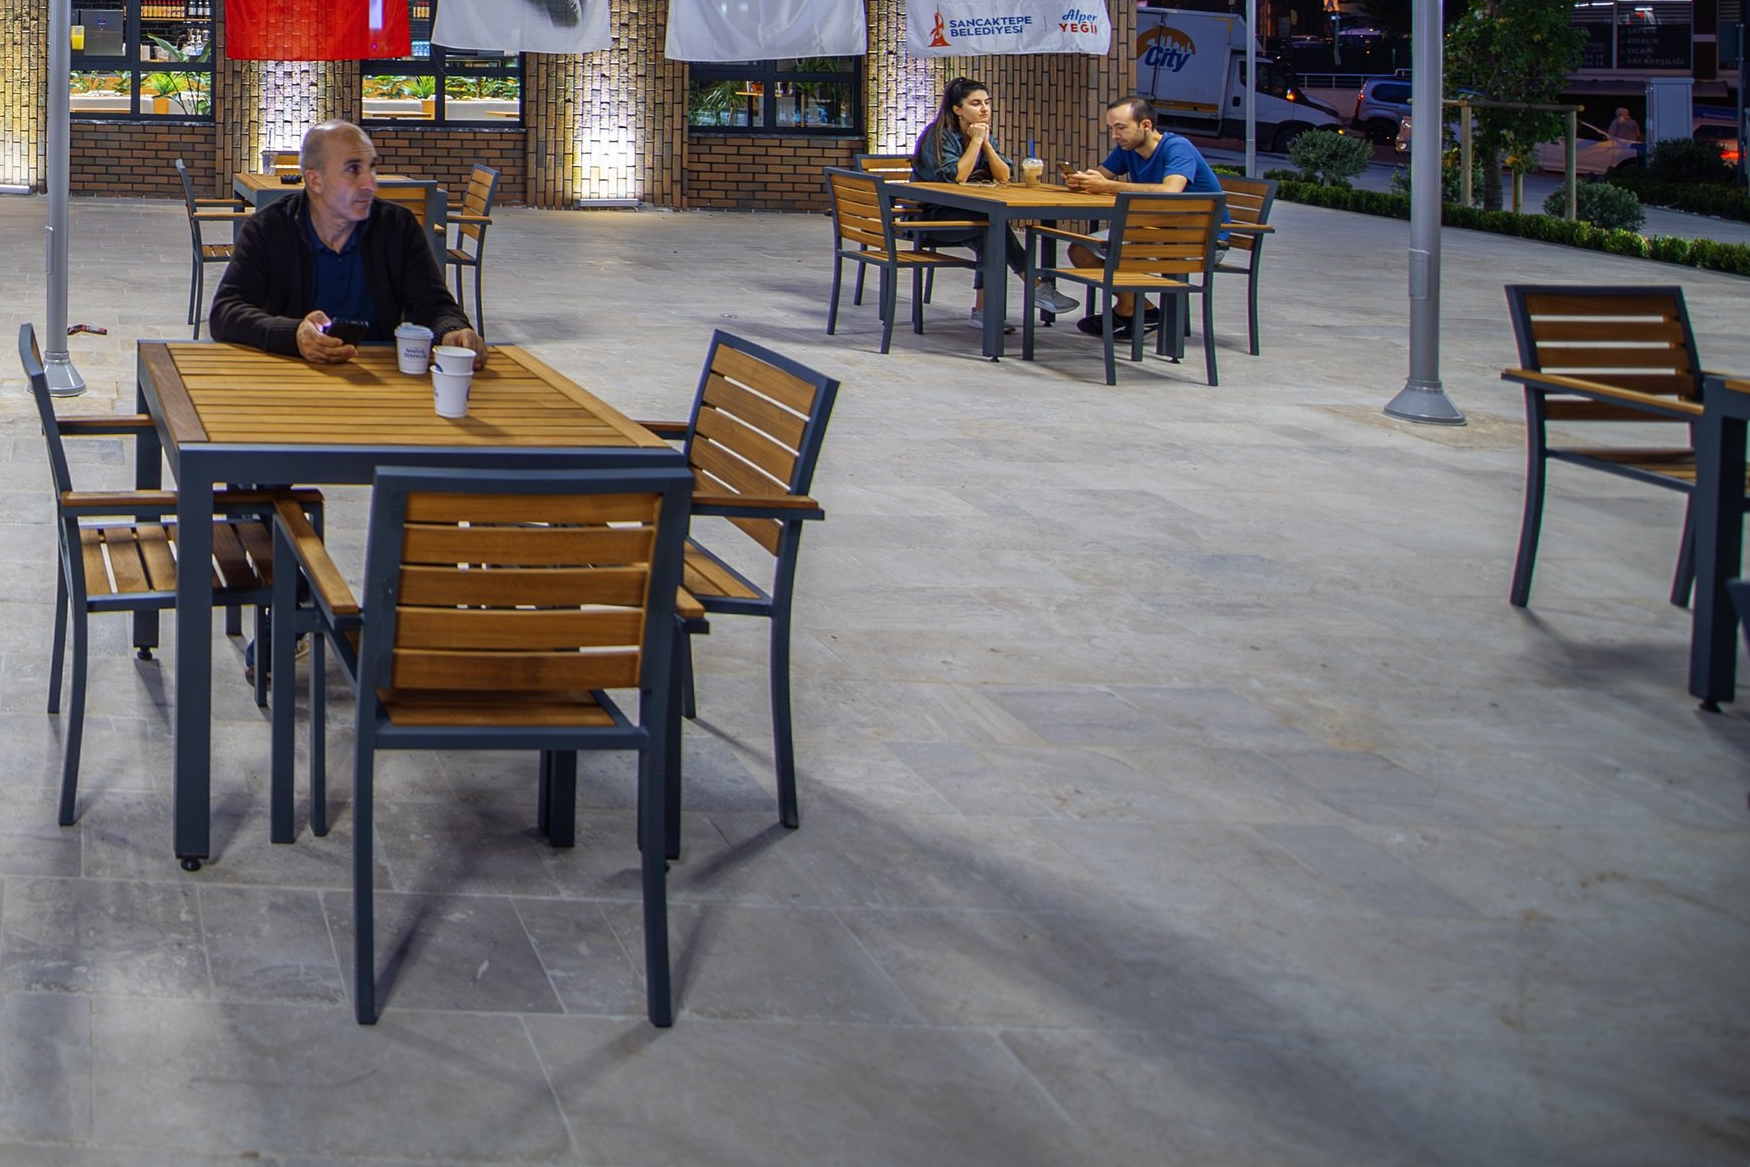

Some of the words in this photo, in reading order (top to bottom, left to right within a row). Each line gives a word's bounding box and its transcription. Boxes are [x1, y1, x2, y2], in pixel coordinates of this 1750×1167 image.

[949, 16, 1032, 29] SANCAKTEPE
[1061, 9, 1098, 24] Alper
[950, 25, 1023, 37] BELEDİYESİ
[1144, 46, 1191, 73] City
